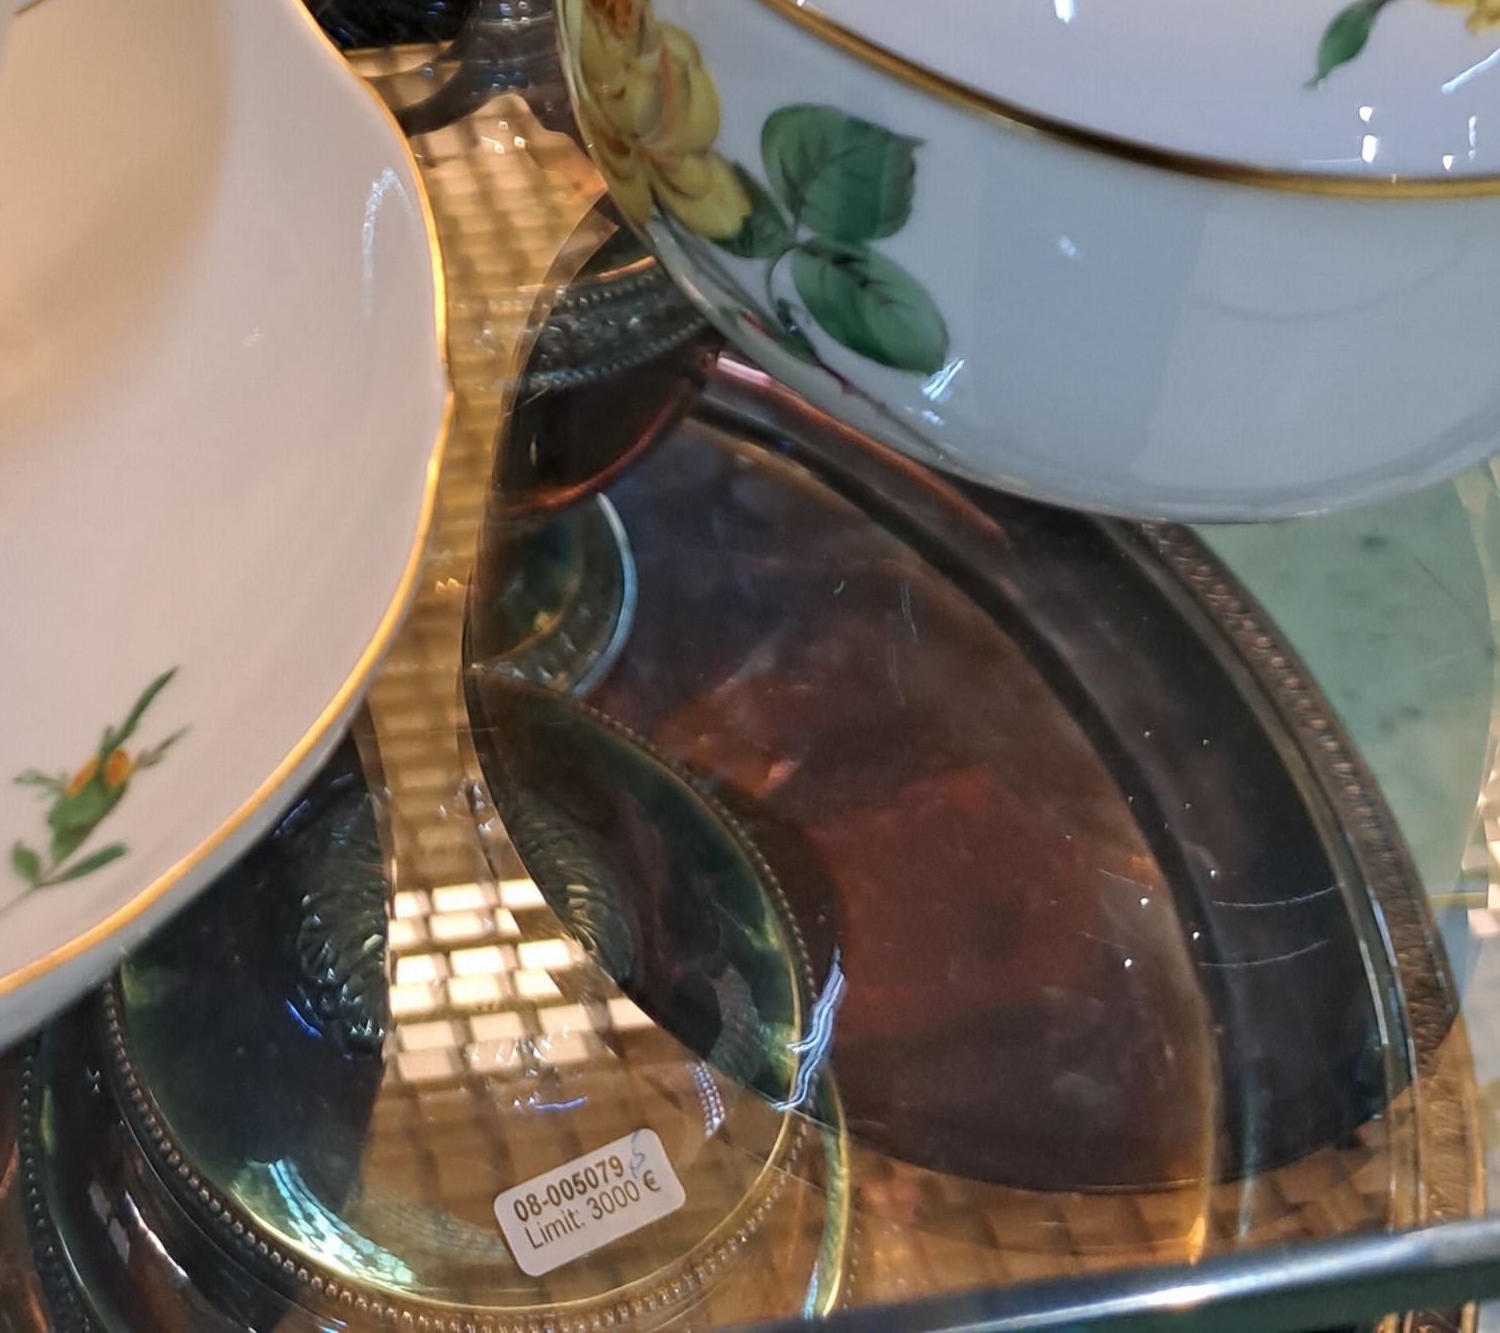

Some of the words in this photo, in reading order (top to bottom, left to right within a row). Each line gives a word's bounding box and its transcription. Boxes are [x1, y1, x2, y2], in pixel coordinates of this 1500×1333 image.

[513, 1155, 624, 1222] 08-005079
[524, 1208, 586, 1249] Limit:
[586, 1180, 640, 1220] 3000
[643, 1169, 661, 1193] €
